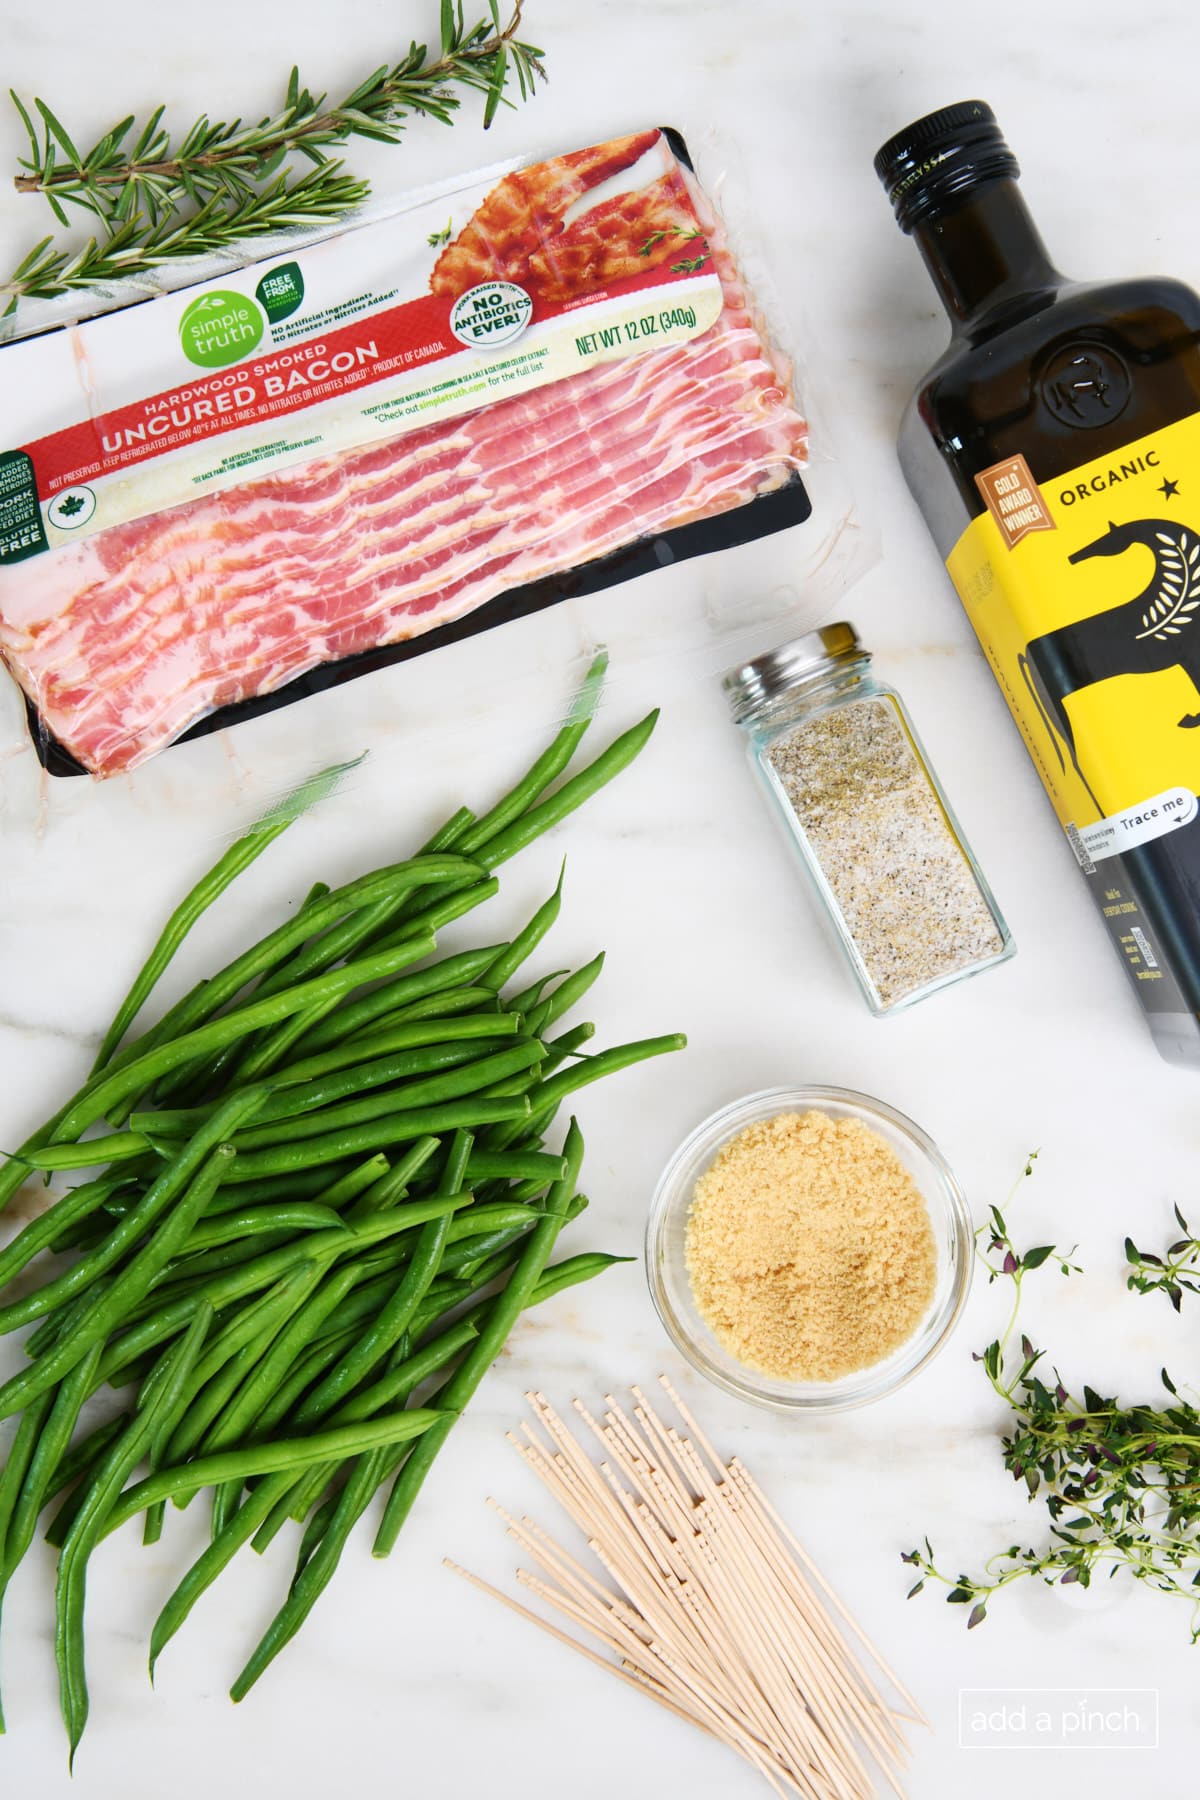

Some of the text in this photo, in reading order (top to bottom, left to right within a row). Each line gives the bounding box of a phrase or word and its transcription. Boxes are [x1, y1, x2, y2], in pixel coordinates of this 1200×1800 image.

[262, 274, 291, 290] FREE
[265, 282, 295, 299] FROM
[271, 327, 283, 335] NO
[285, 311, 324, 331] Artificial
[325, 292, 373, 316] Ingredients
[455, 297, 531, 331] ANTIBIOTICS
[472, 293, 502, 312] NO
[191, 308, 249, 338] simple
[273, 335, 285, 343] NO
[287, 320, 322, 338] Nitrates
[334, 303, 366, 320] Nitrites
[472, 312, 520, 337] EVER!
[575, 306, 697, 356] NET WT 12 OZ (340g)
[195, 323, 255, 354] truth
[145, 344, 327, 416] HARDWOOD SMOKED
[405, 404, 419, 415] out
[419, 382, 487, 410] simpletruth.com
[488, 377, 500, 387] for
[501, 371, 515, 382] the
[516, 366, 530, 377] full
[531, 362, 544, 373] list
[102, 340, 379, 453] UNCURED BACON
[48, 476, 63, 490] NOT
[63, 462, 102, 483] PRESERVED.
[103, 455, 120, 469] KEEP
[120, 437, 168, 462] REFRIGERATED
[167, 428, 192, 445] BELOW
[210, 418, 219, 430] AT
[221, 415, 233, 427] ALL
[234, 408, 258, 421] TIMES.
[258, 405, 269, 415] NO
[268, 394, 303, 412] NITRATES
[302, 388, 313, 398] OR
[312, 379, 344, 397] NITRITES
[373, 355, 405, 375] PRODUCT
[404, 351, 414, 363] OF
[413, 341, 446, 360] CANADA.
[1, 463, 28, 479] ADDED
[993, 472, 1020, 496] GOLD
[1060, 451, 1161, 506] ORGANIC
[15, 508, 34, 523] DIET
[998, 487, 1033, 515] AWARD
[1003, 503, 1043, 533] WINNER
[0, 530, 42, 557] FREE
[1120, 797, 1184, 830] Trace me
